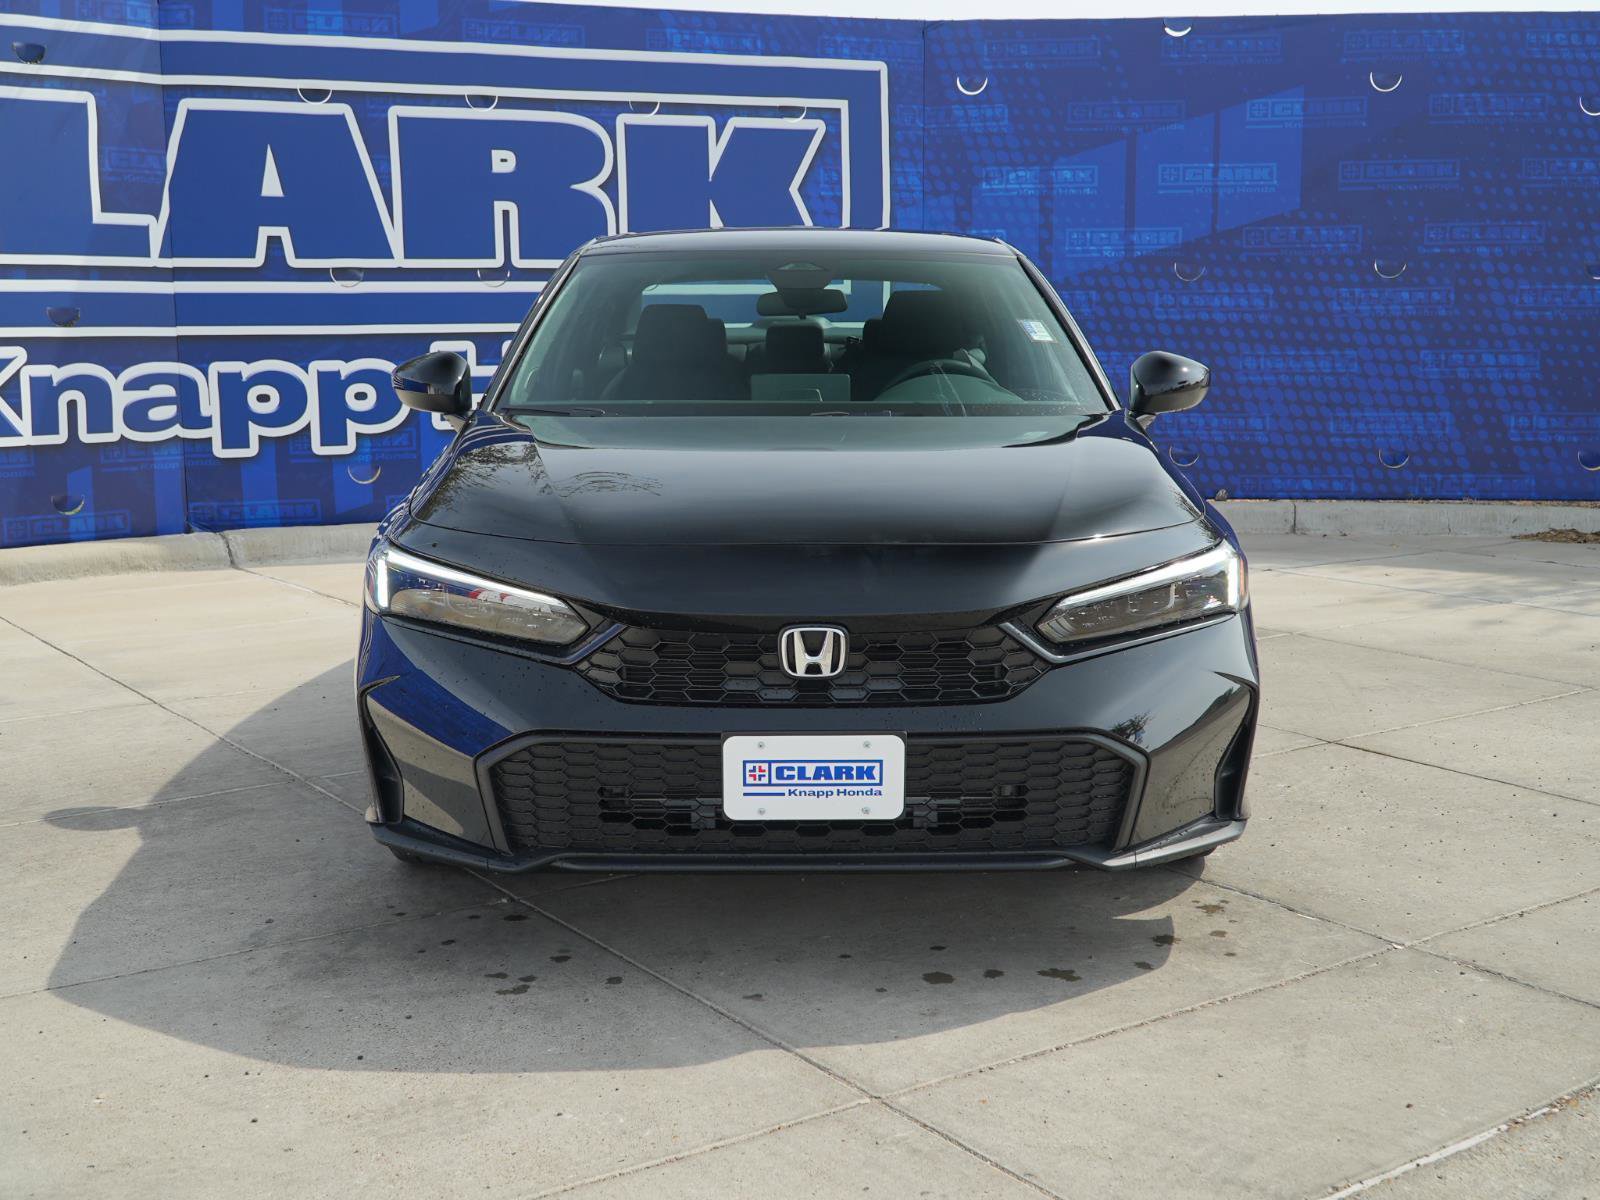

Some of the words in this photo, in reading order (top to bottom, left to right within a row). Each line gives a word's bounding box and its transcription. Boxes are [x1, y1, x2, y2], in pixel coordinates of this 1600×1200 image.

[1184, 167, 1271, 182] CLARK
[0, 344, 412, 458] napp
[775, 765, 876, 781] CLARK
[788, 788, 834, 799] Knapp
[836, 788, 883, 797] Honda
